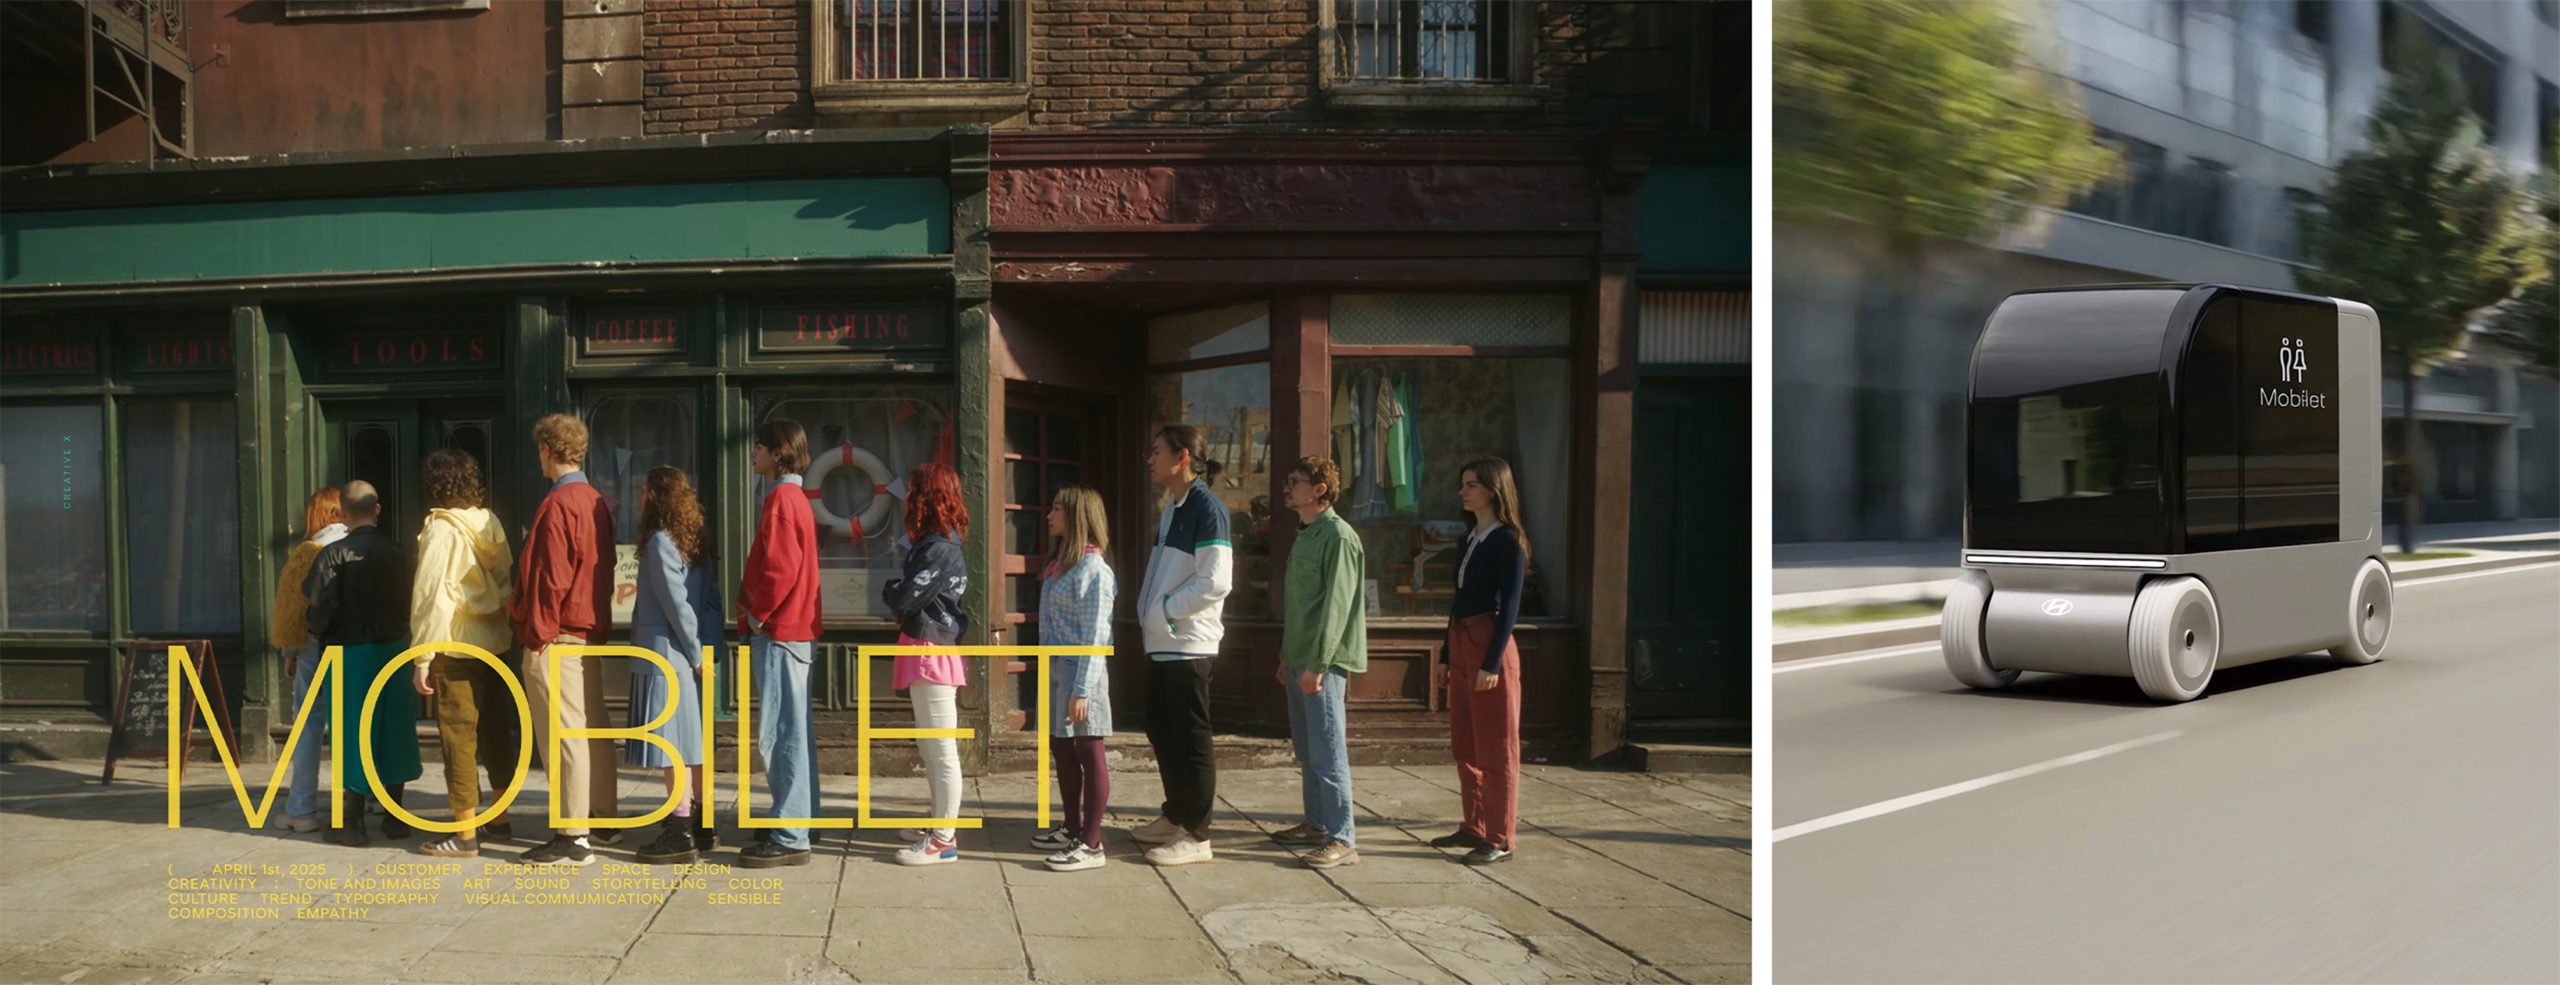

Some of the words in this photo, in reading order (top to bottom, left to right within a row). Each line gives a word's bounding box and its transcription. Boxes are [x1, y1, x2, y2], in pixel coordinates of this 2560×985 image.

[594, 319, 679, 344] COFFEE
[797, 314, 910, 341] FISHING
[348, 337, 486, 367] TOOLS
[2260, 388, 2326, 408] Mobilet
